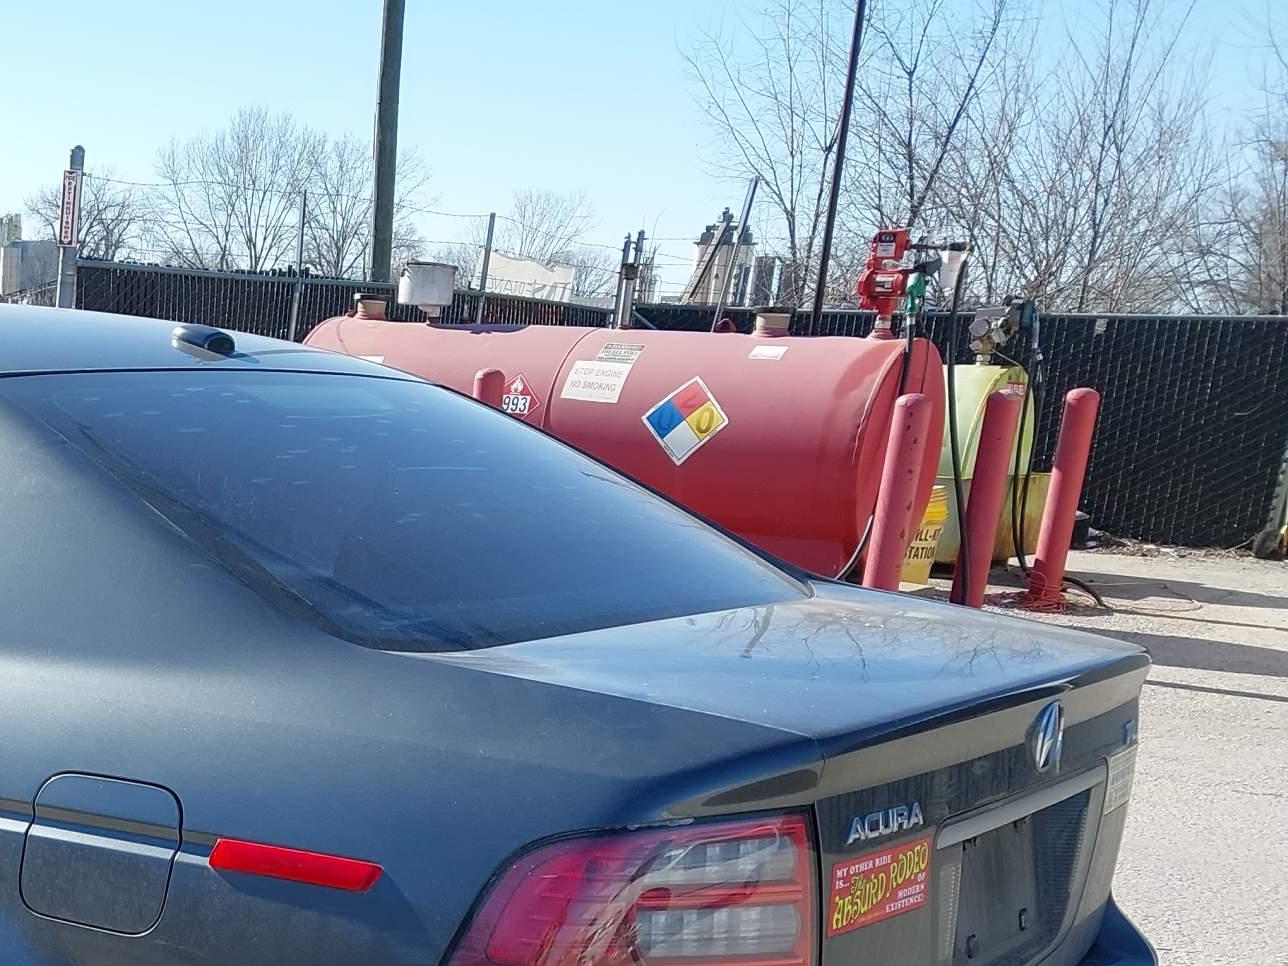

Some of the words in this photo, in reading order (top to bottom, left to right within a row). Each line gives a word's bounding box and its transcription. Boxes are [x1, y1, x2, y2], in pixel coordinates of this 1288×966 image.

[63, 181, 73, 240] EXTINGUISHER
[574, 367, 595, 376] STOP
[595, 369, 624, 379] ENGINE
[570, 380, 581, 389] NO
[581, 381, 617, 392] SMOKING
[503, 396, 528, 413] 993
[696, 407, 715, 433] 0
[846, 801, 924, 845] ACURA
[836, 866, 849, 879] MY
[849, 860, 874, 875] OTHER
[875, 854, 892, 867] RIDE
[886, 842, 929, 898] RODEO
[917, 872, 927, 882] OF
[897, 882, 925, 899] MODERN
[886, 893, 924, 913] EXISTENCE!
